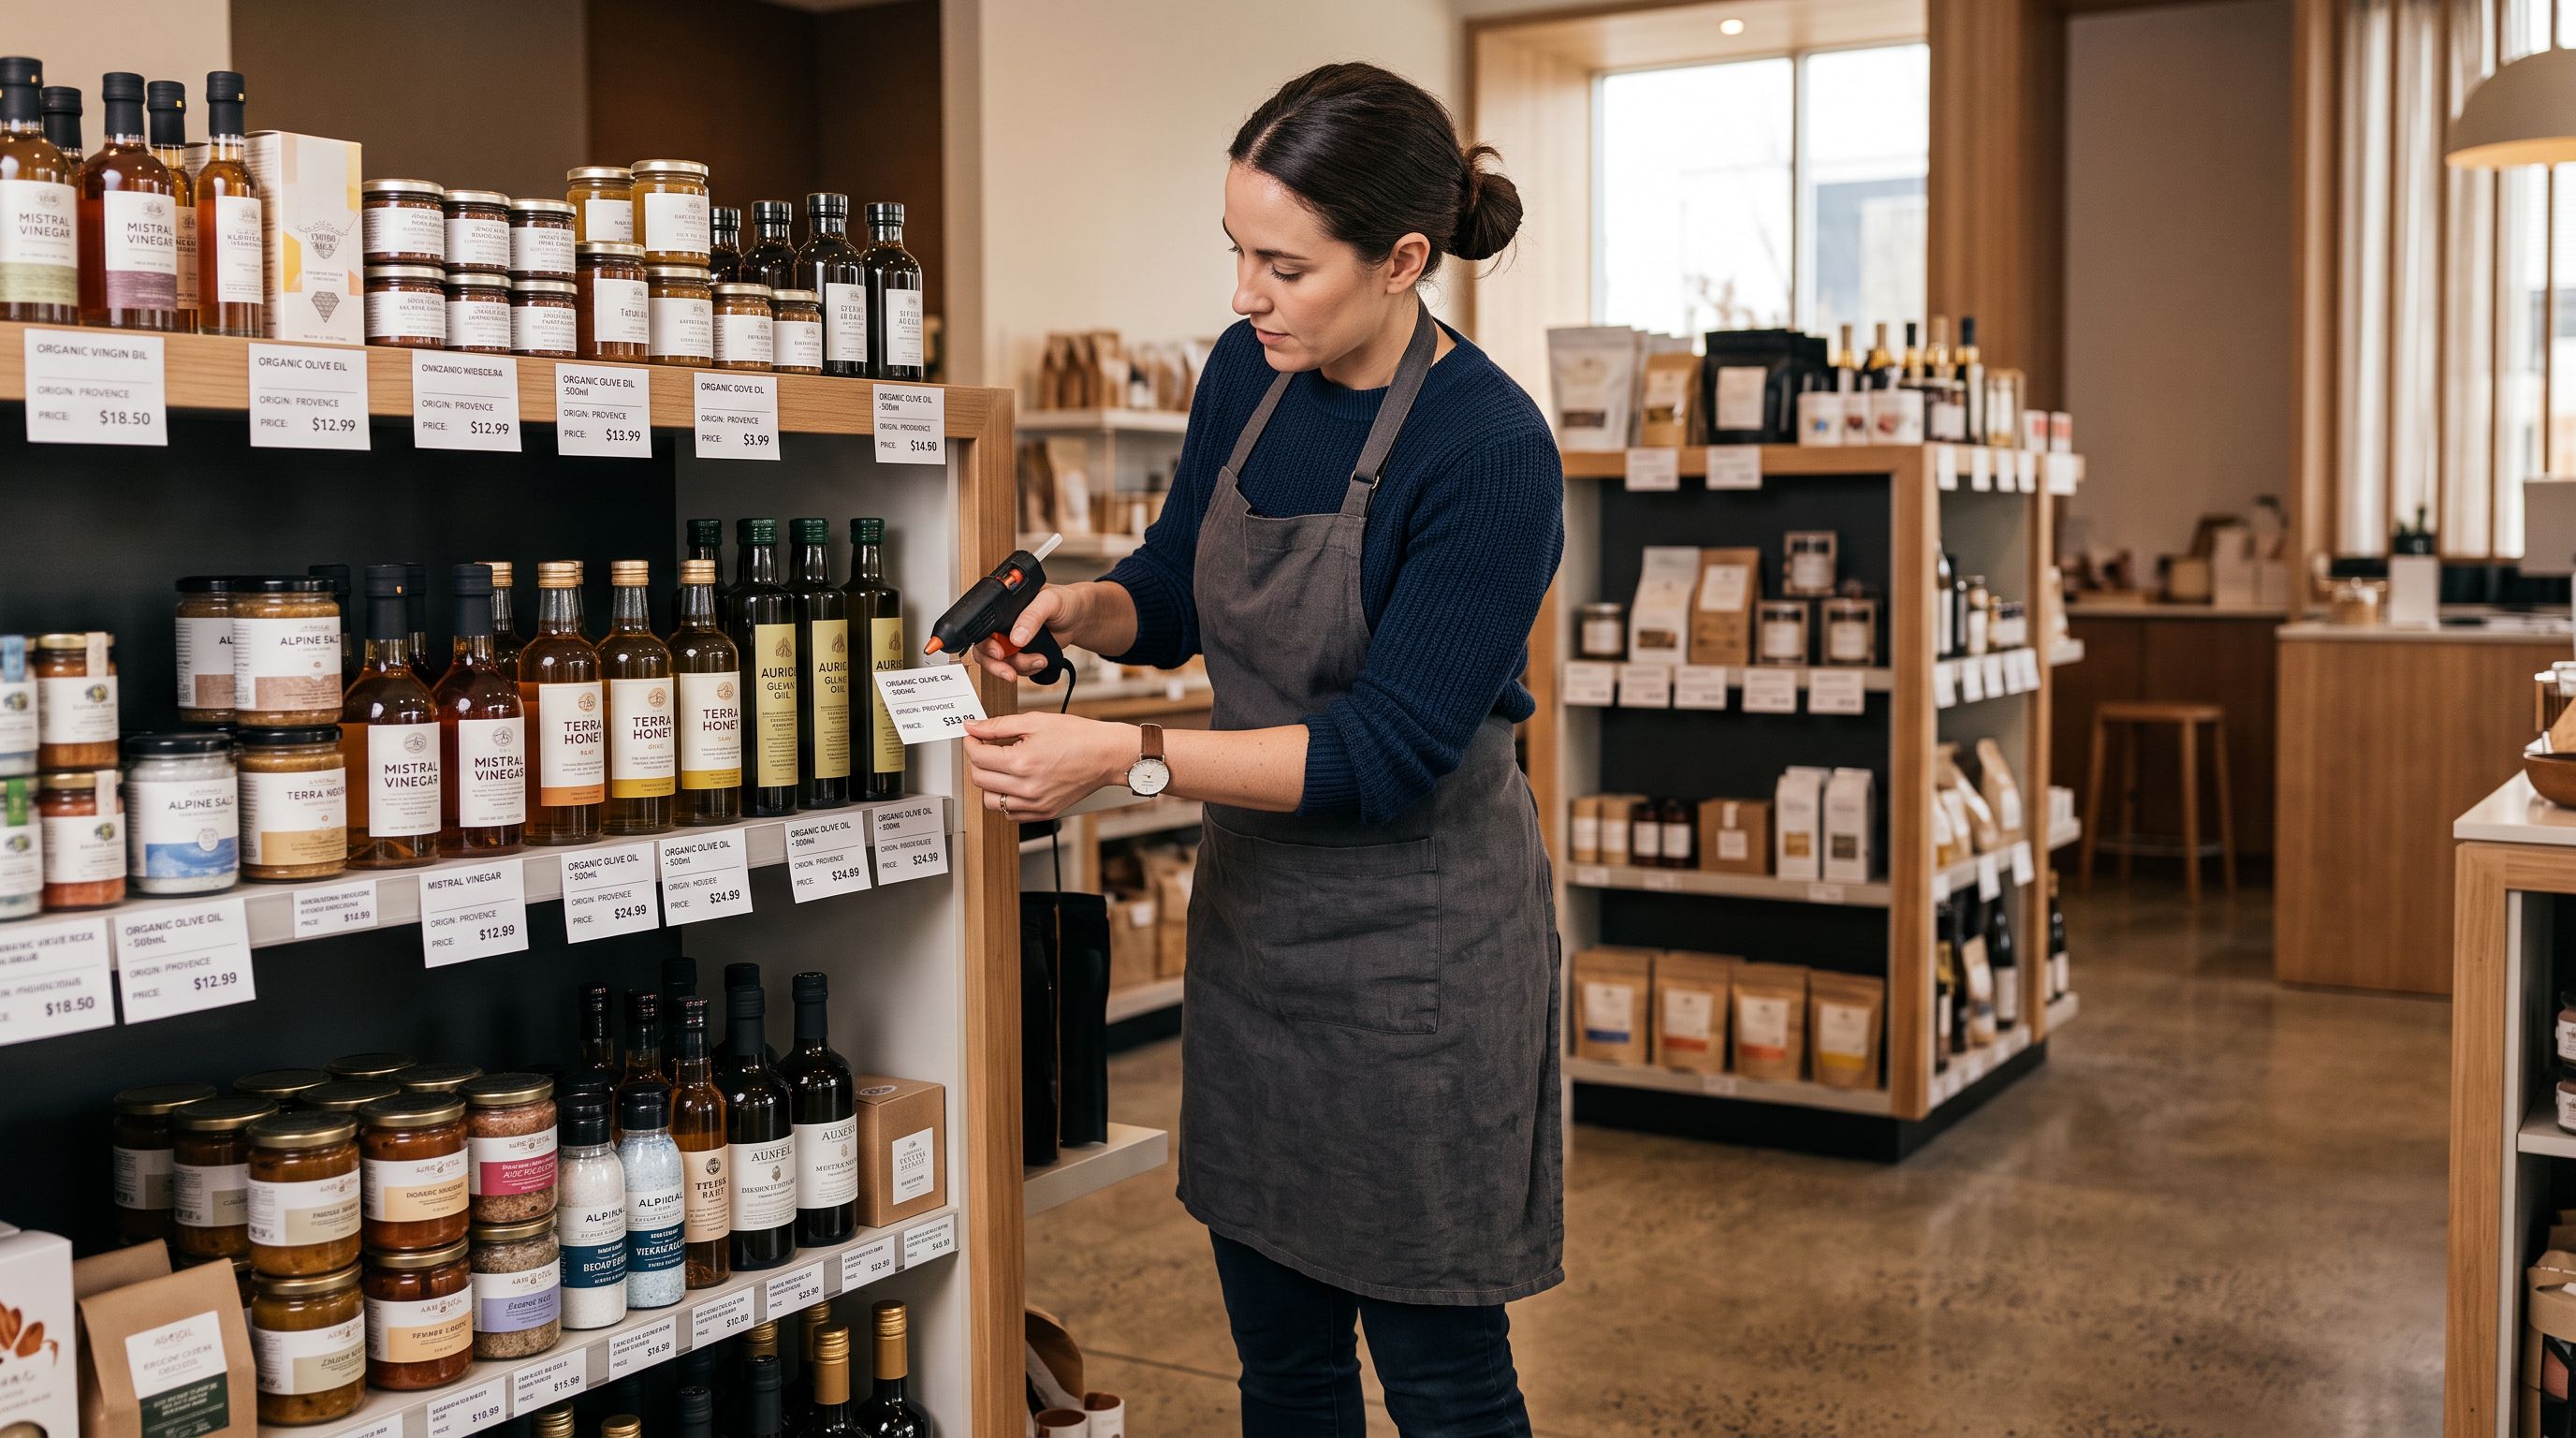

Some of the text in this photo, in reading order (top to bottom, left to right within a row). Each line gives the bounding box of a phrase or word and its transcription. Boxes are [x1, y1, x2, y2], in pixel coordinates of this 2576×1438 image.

[19, 213, 70, 227] MISTRAL
[127, 222, 172, 236] MISTRAL
[37, 344, 89, 357] ORGANIC
[258, 356, 302, 369] ORGANIC
[304, 360, 331, 372] OLIVE
[563, 374, 599, 386] ORGANIC
[79, 387, 131, 400] PROVENCE
[700, 382, 733, 393] ORGANIC
[421, 399, 494, 412] ORIGIN: PROVENCE
[99, 408, 152, 426] $18.50
[592, 410, 628, 420] PROVENCE
[700, 414, 759, 425] ORIGIN: PROVENCE
[313, 416, 357, 432] $12.99
[422, 419, 510, 435] PRICE: $12.99
[564, 427, 642, 443] PRICE: $13.99
[743, 432, 770, 448] $3.99
[280, 636, 322, 647] ALPINE
[703, 708, 739, 720] TERRA
[564, 719, 602, 733] TERRA
[632, 715, 671, 729] TERRA
[384, 761, 438, 775] MISTRAL
[475, 755, 524, 769] MISTRAL
[287, 788, 324, 800] TERRA
[168, 797, 216, 812] ALPINE
[923, 806, 933, 816] OIL
[790, 826, 821, 839] ORGANIC
[841, 821, 852, 831] OIL
[664, 839, 732, 858] ORGANIC OLIVE OIL
[568, 858, 603, 872] ORGANIC
[626, 853, 639, 862] OIL
[912, 851, 939, 867] $24.99
[428, 871, 503, 891] MISTRAL VINEGAR
[668, 880, 693, 892] ORIGIN:
[710, 888, 741, 905] $24.99
[459, 910, 497, 923] PROVENCE
[614, 904, 648, 920] $24.99
[125, 913, 224, 937] ORGANIC OLIVE OIL
[479, 924, 516, 941] $12.99
[194, 971, 238, 990] $12.99
[46, 995, 95, 1018] $18.50
